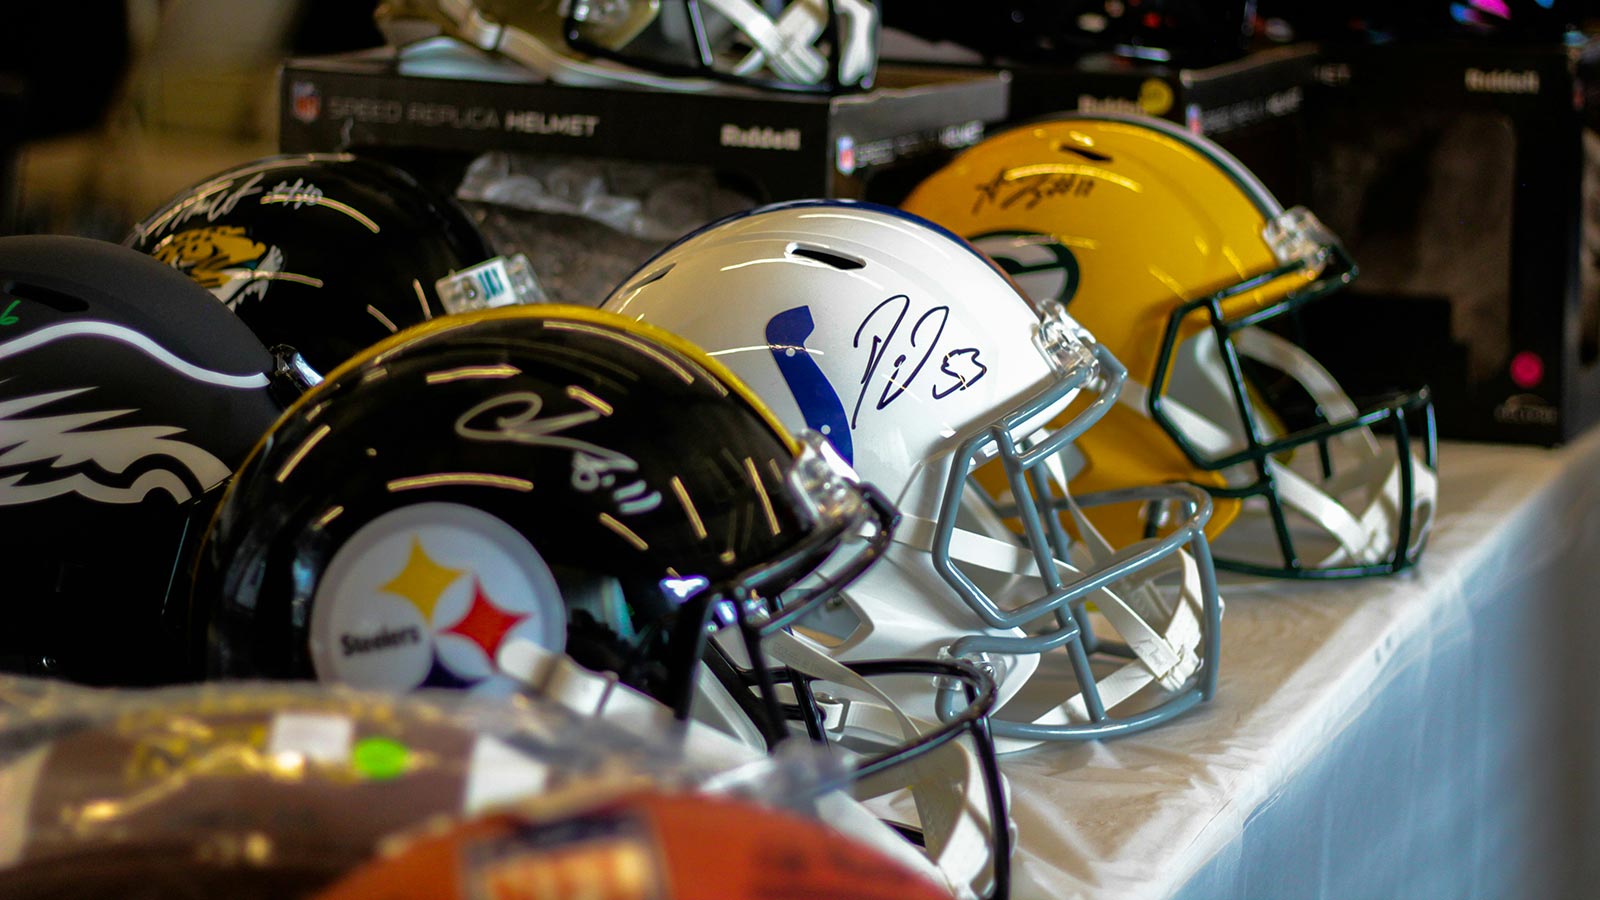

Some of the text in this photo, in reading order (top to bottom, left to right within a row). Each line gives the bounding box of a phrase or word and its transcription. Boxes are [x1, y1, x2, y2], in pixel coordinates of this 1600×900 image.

[328, 97, 402, 124] SPEED
[407, 103, 500, 131] REPLICA
[504, 110, 600, 138] HELMET
[1078, 94, 1149, 115] Ridde
[721, 124, 801, 151] Riddell
[932, 348, 987, 400] 53
[341, 626, 419, 656] Steelers
